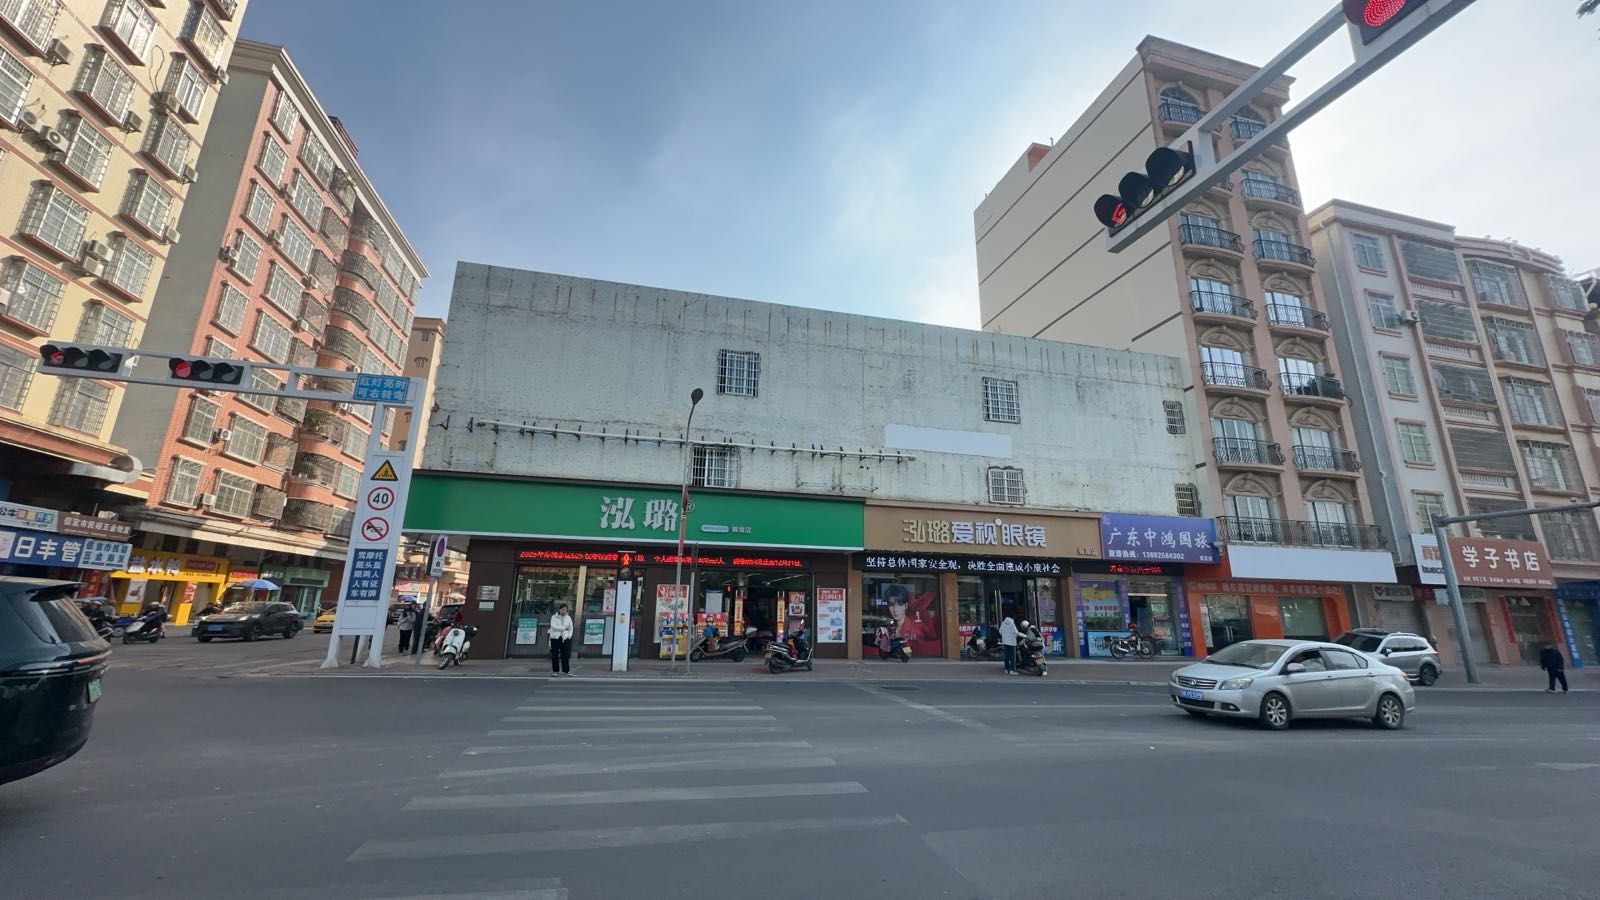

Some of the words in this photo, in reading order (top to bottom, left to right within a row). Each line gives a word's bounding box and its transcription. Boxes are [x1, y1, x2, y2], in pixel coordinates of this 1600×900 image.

[359, 376, 405, 390] 红灯亮时
[358, 388, 403, 400] 可右转弯
[372, 493, 389, 504] 40
[600, 496, 679, 532] 泓璐
[1107, 526, 1212, 549] 广东中鸿国旅
[14, 536, 82, 563] 日丰管
[358, 551, 384, 560] 驾摩托
[1462, 545, 1541, 572] 学子书店
[355, 561, 382, 569] 戴头盔
[353, 570, 379, 578] 限两人
[351, 580, 379, 588] 人有证
[350, 589, 377, 598] 车有牌
